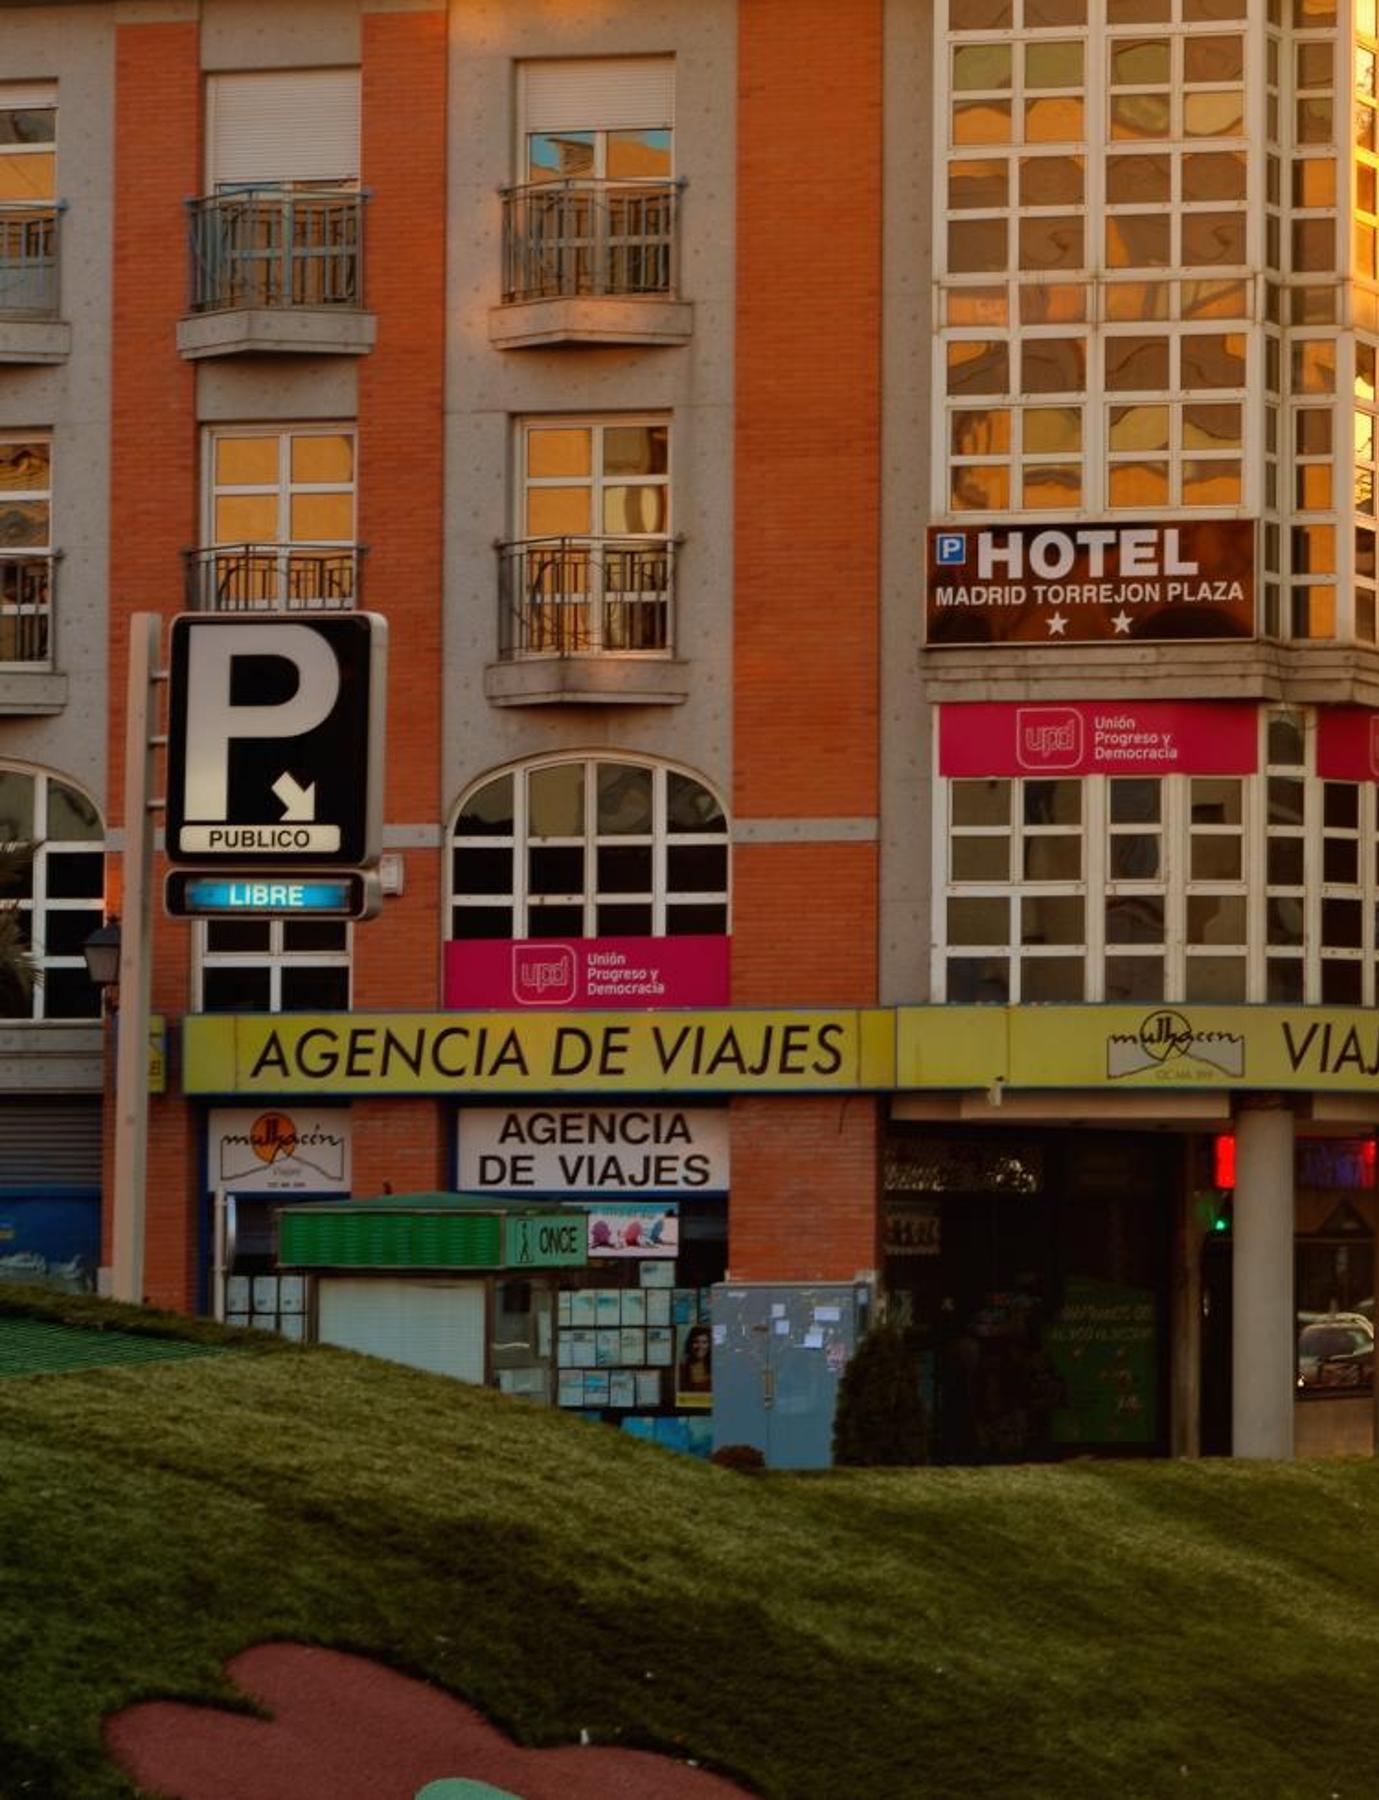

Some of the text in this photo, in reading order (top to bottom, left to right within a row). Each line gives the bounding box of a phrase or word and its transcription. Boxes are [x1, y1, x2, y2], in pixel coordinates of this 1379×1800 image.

[977, 528, 1199, 579] HOTEL
[935, 581, 1244, 608] MADRID TORREJON PLAZA
[183, 624, 341, 822] P
[1094, 715, 1136, 730] Unión
[1094, 731, 1171, 749] Progreso y
[1094, 747, 1179, 761] Democracia
[208, 828, 311, 850] PUBLICO
[229, 884, 305, 907] LIBRE
[588, 952, 627, 966] Unión
[588, 968, 660, 983] Progreso y
[588, 982, 665, 996] Democracia
[250, 1023, 843, 1078] AGENCIA DE VIAJES
[498, 1111, 693, 1145] AGENCIA
[478, 1154, 711, 1187] DE VIAJES
[539, 1227, 579, 1254] ONCE
